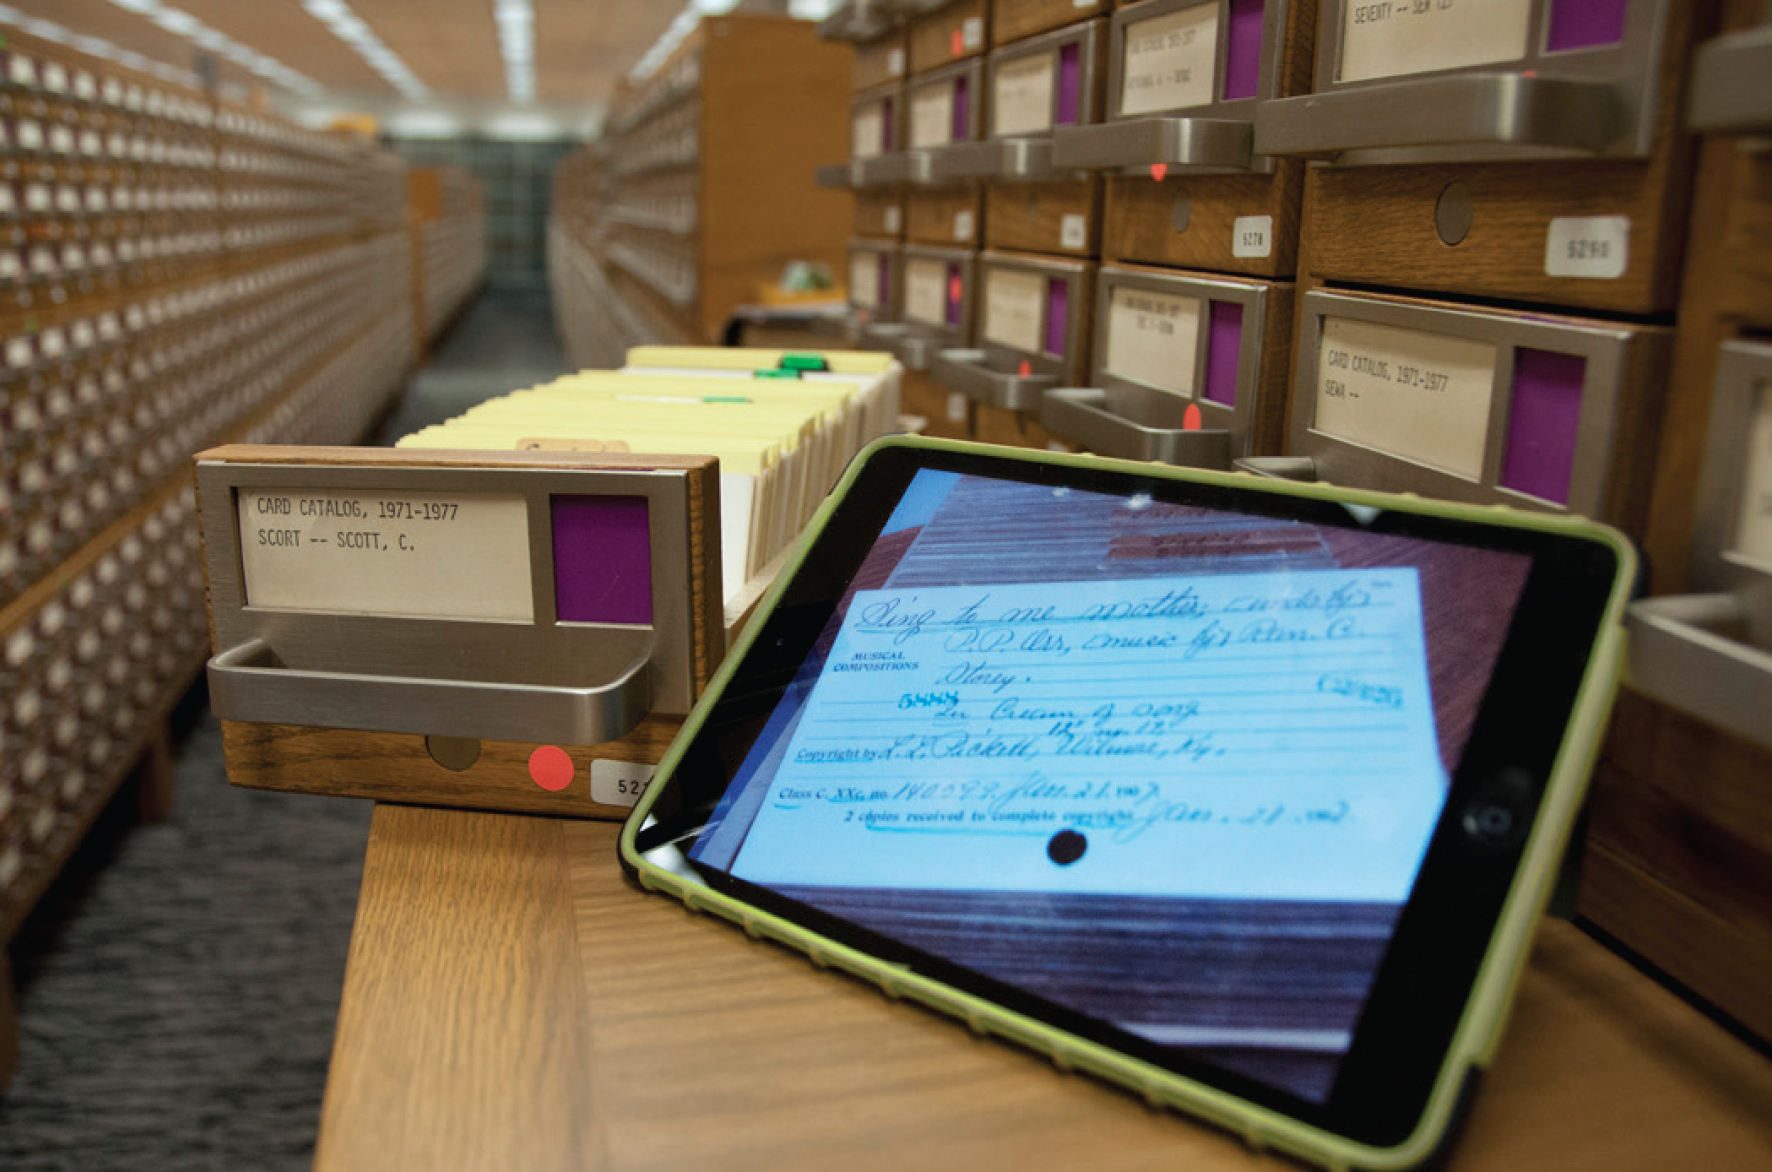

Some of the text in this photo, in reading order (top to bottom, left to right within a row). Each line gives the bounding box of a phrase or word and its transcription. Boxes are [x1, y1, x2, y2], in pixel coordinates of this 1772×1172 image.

[1396, 364, 1450, 393] 1971-1977
[257, 497, 459, 521] CARD CATALOG, 1971-1977
[258, 528, 302, 547] SCORT
[336, 531, 388, 551] SCOTT,
[398, 533, 416, 551] C.
[952, 593, 991, 625] to
[1000, 605, 1057, 622] me
[852, 651, 906, 661] MUSICAL
[833, 661, 920, 672] COMPOSITIONS
[796, 748, 859, 761] Copyright
[778, 787, 812, 800] Class
[844, 810, 854, 822] 2
[858, 809, 899, 823] copies
[906, 810, 965, 822] received
[971, 810, 986, 822] to
[991, 810, 1056, 823] complete
